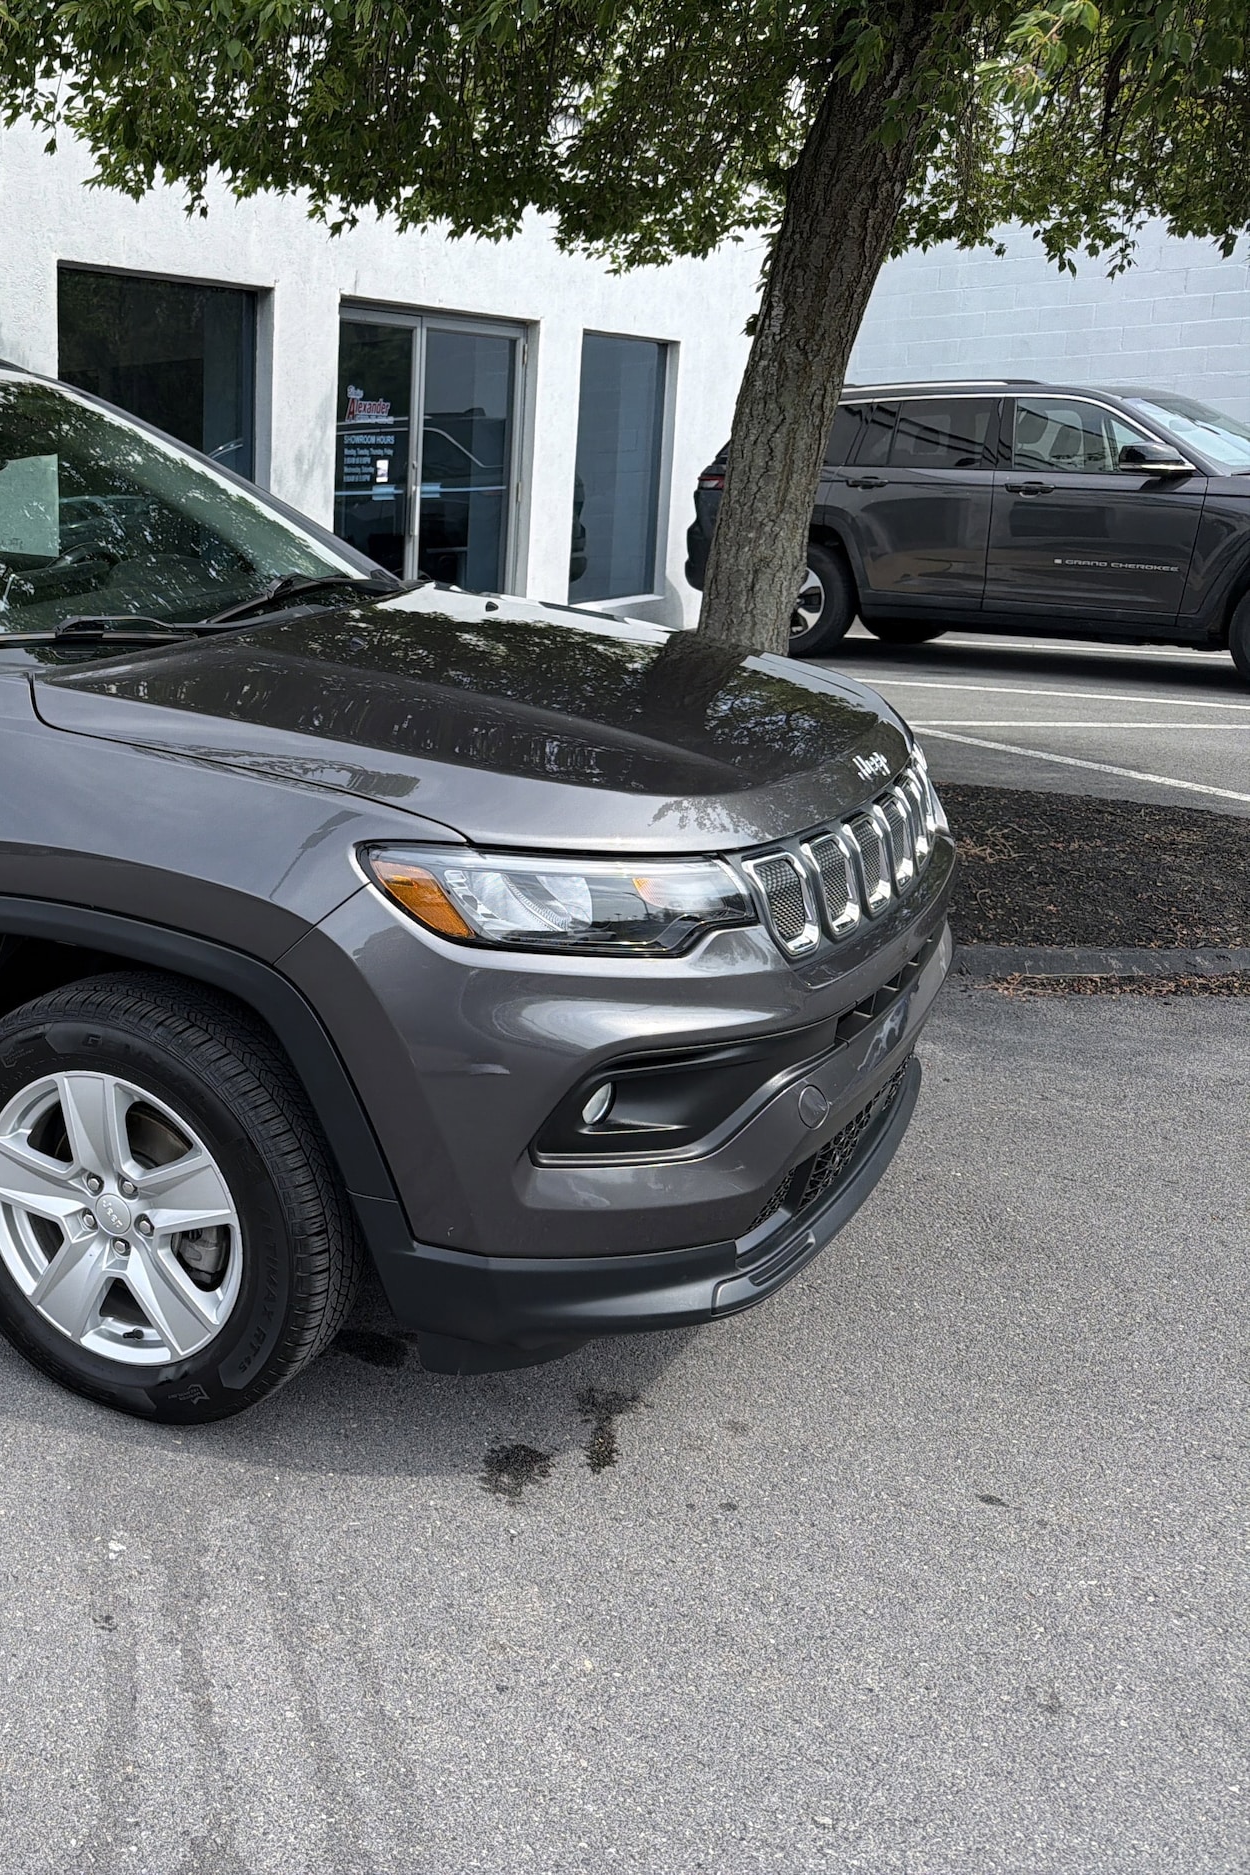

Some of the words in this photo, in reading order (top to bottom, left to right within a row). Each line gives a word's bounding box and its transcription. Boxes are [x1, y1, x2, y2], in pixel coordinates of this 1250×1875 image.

[345, 398, 390, 421] Alexander
[344, 435, 375, 444] SHOWROOM
[376, 435, 395, 444] HOURS
[1065, 559, 1107, 567] GRAND
[1110, 562, 1180, 572] CHEROKEE
[852, 751, 891, 782] Jeep
[101, 1199, 123, 1228] Jeep
